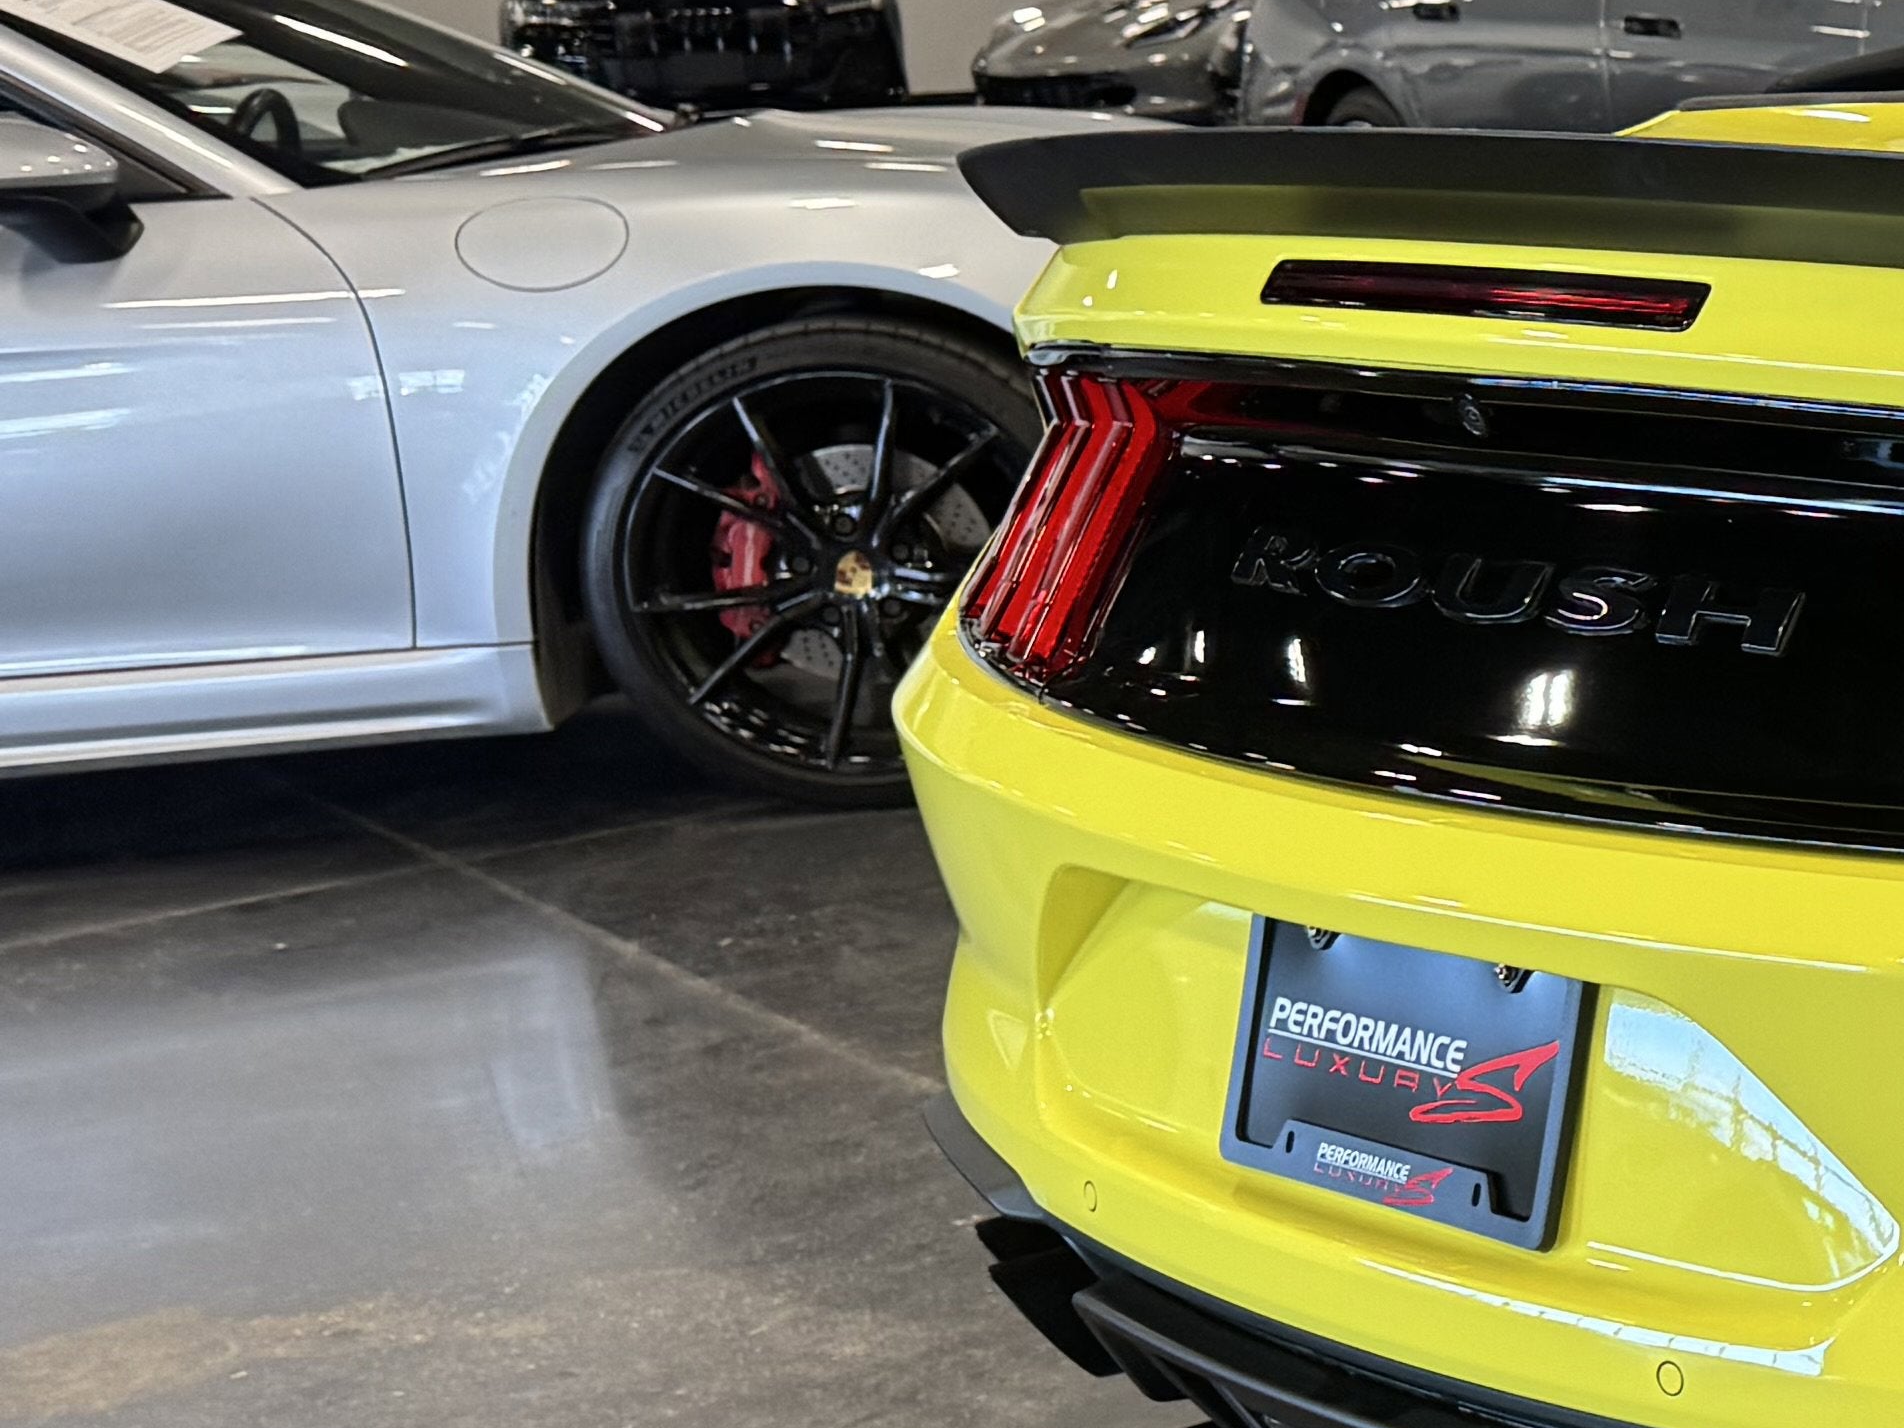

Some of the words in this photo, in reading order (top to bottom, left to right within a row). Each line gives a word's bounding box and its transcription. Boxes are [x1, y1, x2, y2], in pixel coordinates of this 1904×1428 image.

[1229, 525, 1808, 658] ROUSH
[1268, 996, 1468, 1073] PERFORMANCE
[1316, 1141, 1412, 1182] PERFORMANCE
